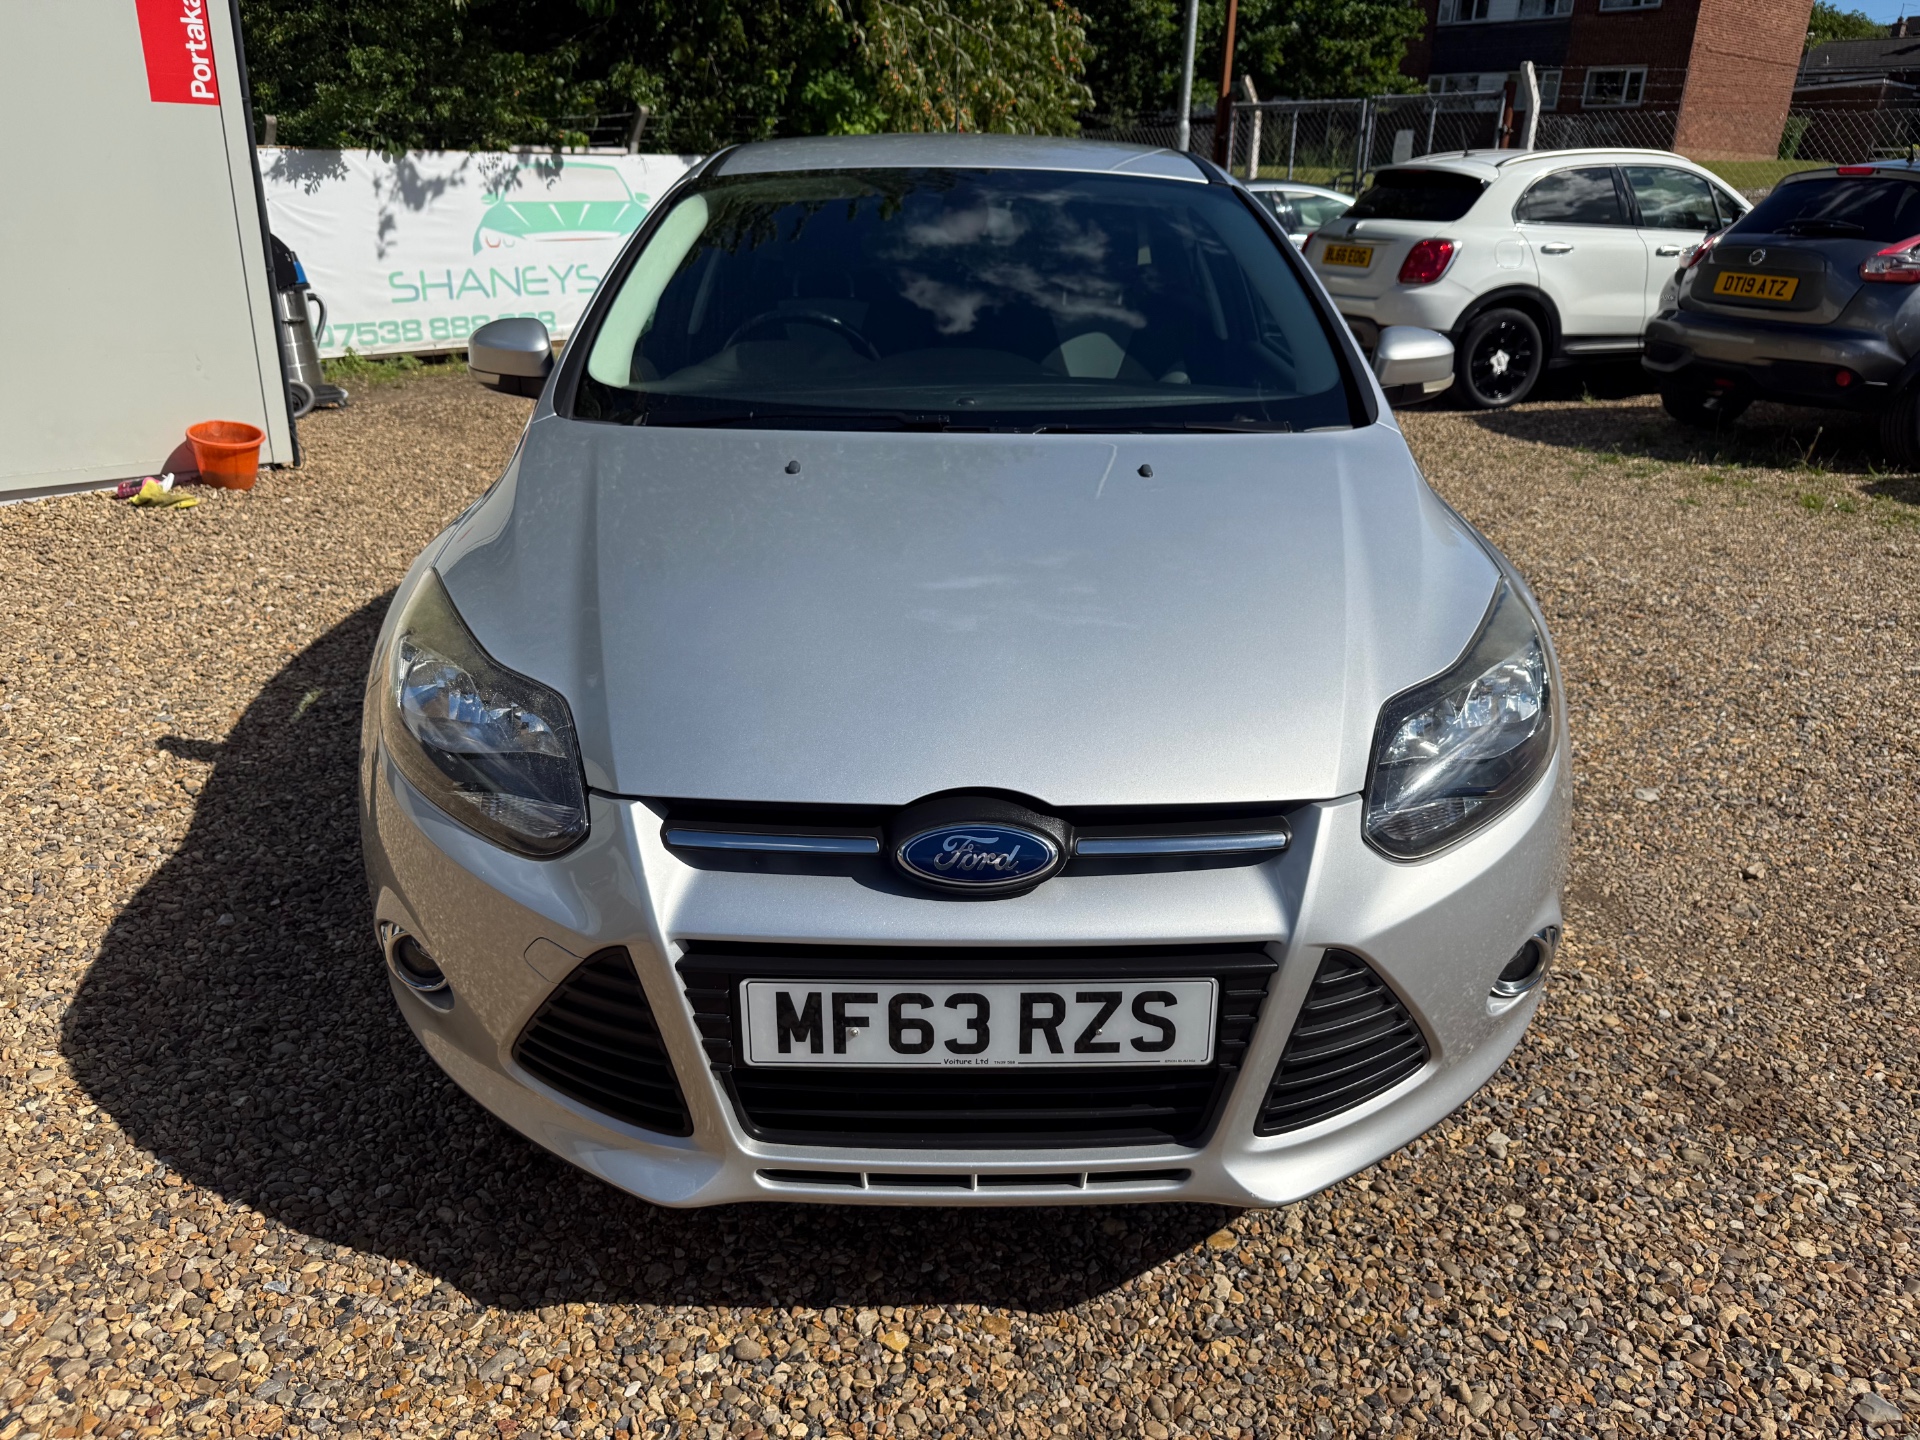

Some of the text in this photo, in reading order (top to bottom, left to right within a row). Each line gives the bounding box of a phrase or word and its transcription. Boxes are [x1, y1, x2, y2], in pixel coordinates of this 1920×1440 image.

[388, 263, 601, 303] SHANEYS
[1723, 275, 1789, 297] DT19 ATZ
[933, 834, 1021, 872] Ford
[775, 989, 1179, 1055] MF63 RZS
